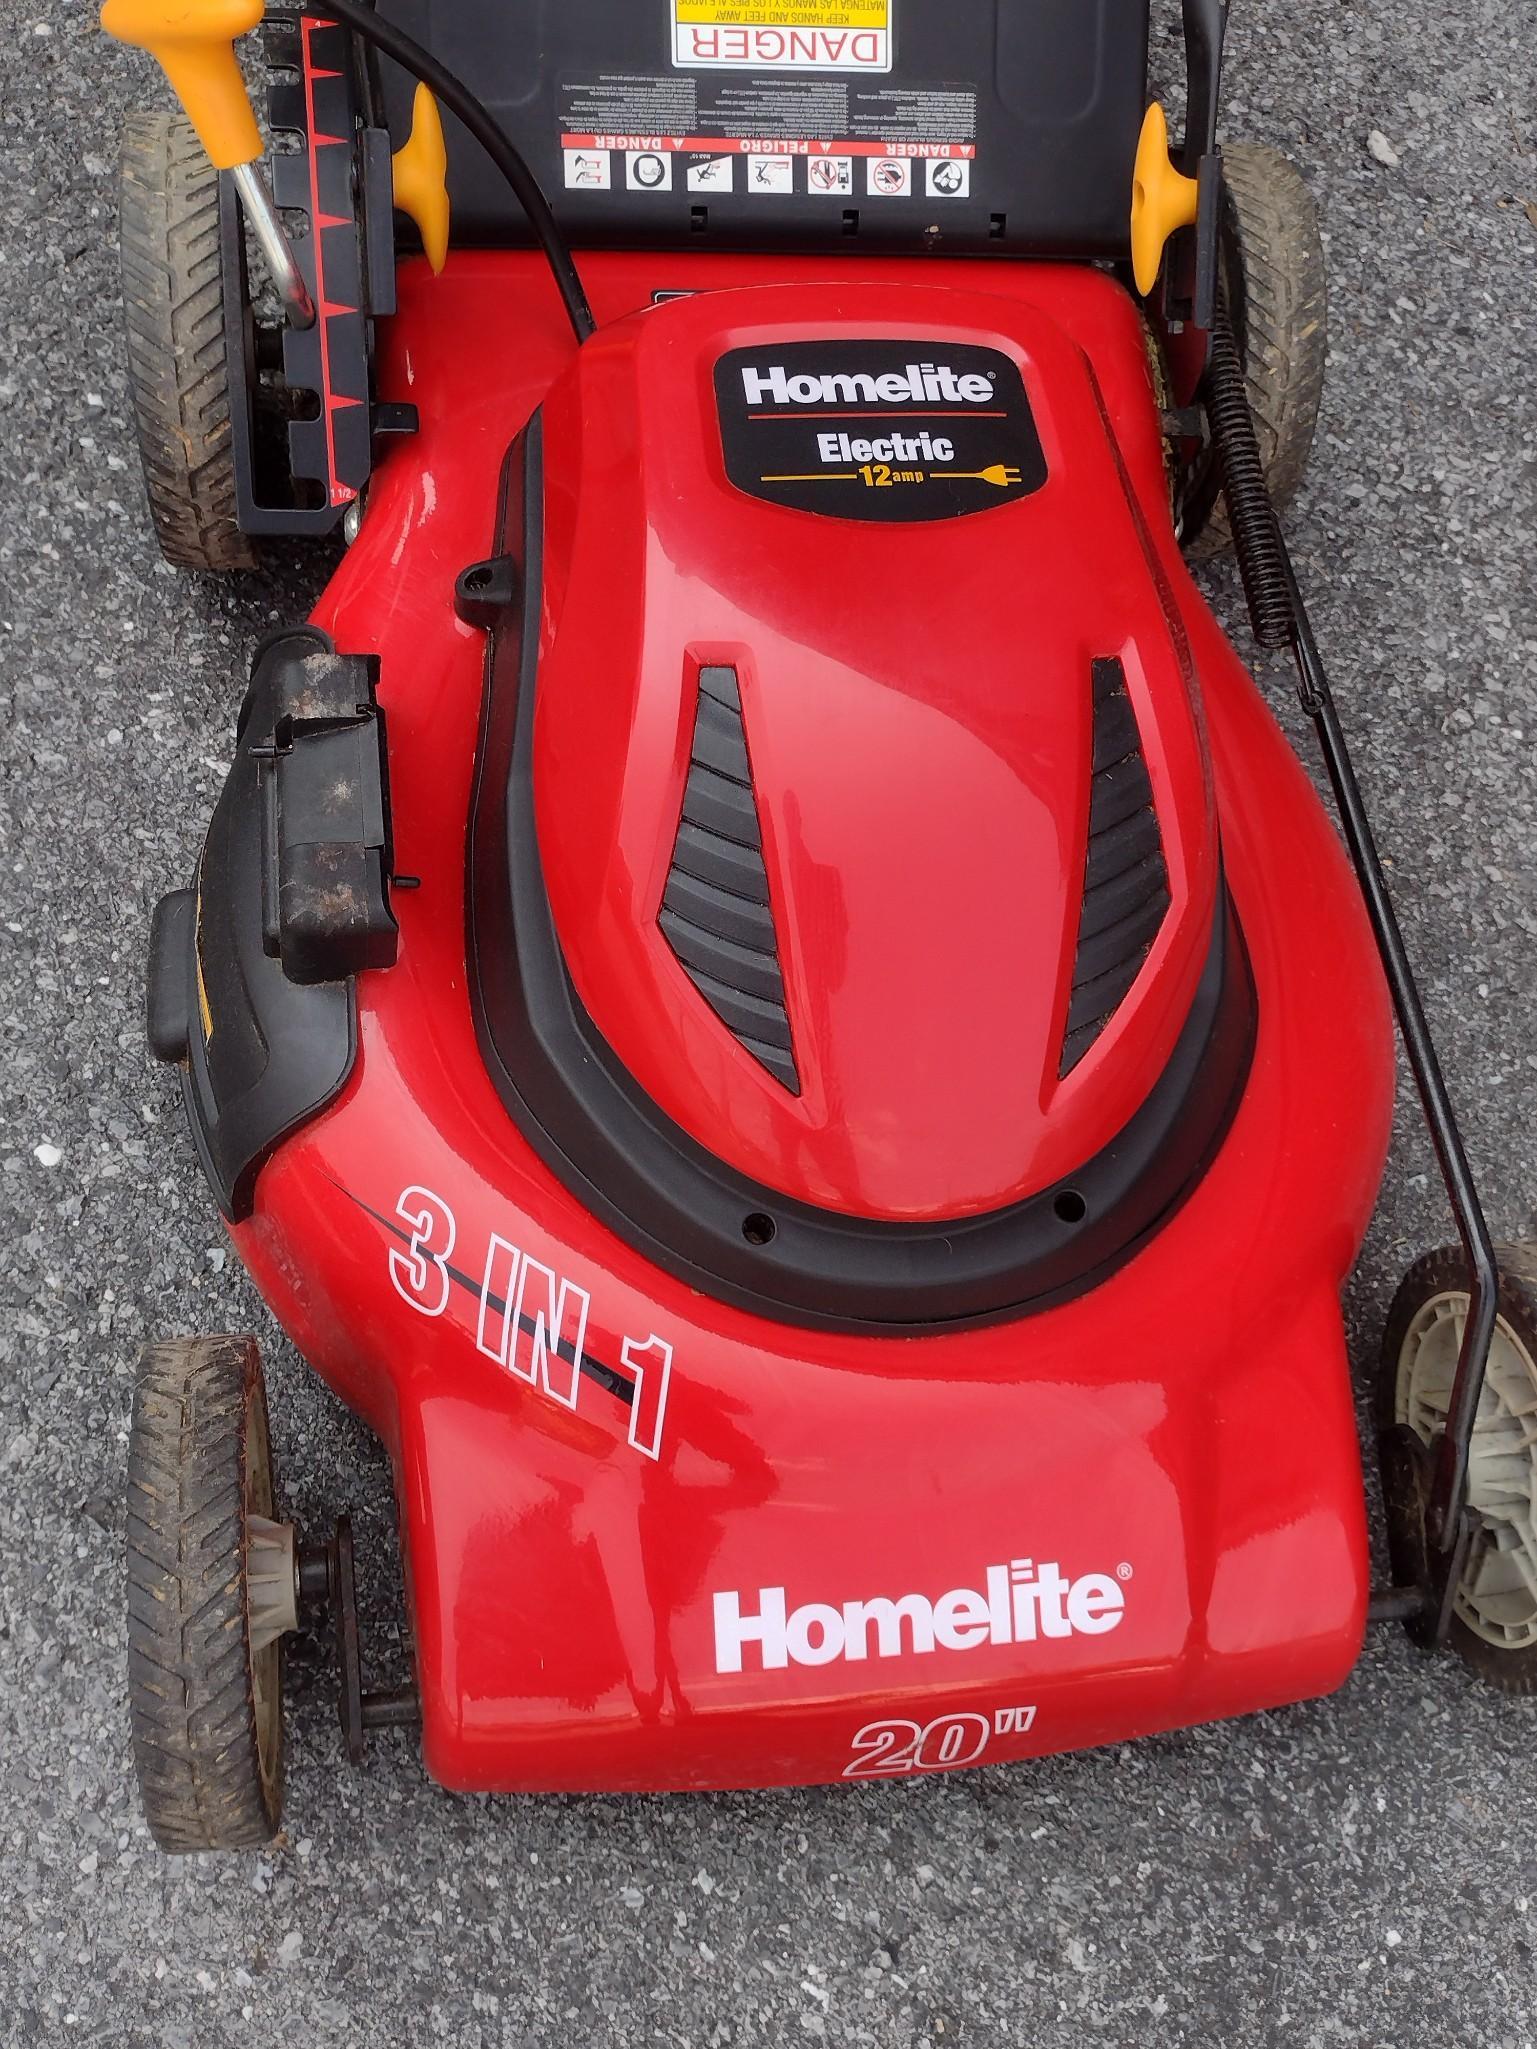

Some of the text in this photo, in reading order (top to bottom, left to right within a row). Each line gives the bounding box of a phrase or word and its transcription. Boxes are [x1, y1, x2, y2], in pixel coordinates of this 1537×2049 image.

[841, 0, 884, 10] MATENGA
[715, 10, 849, 24] KEEP HANDS AND FEET AWAY
[691, 28, 878, 62] DANGER
[594, 136, 662, 150] DANGER
[739, 140, 808, 154] PELIGRO
[886, 144, 950, 157] DANGER
[741, 364, 994, 405] Homelite
[816, 432, 955, 463] Electric
[858, 465, 924, 487] 12 amp
[389, 1185, 674, 1462] 3 IN 1
[713, 1559, 1126, 1674] Homelite
